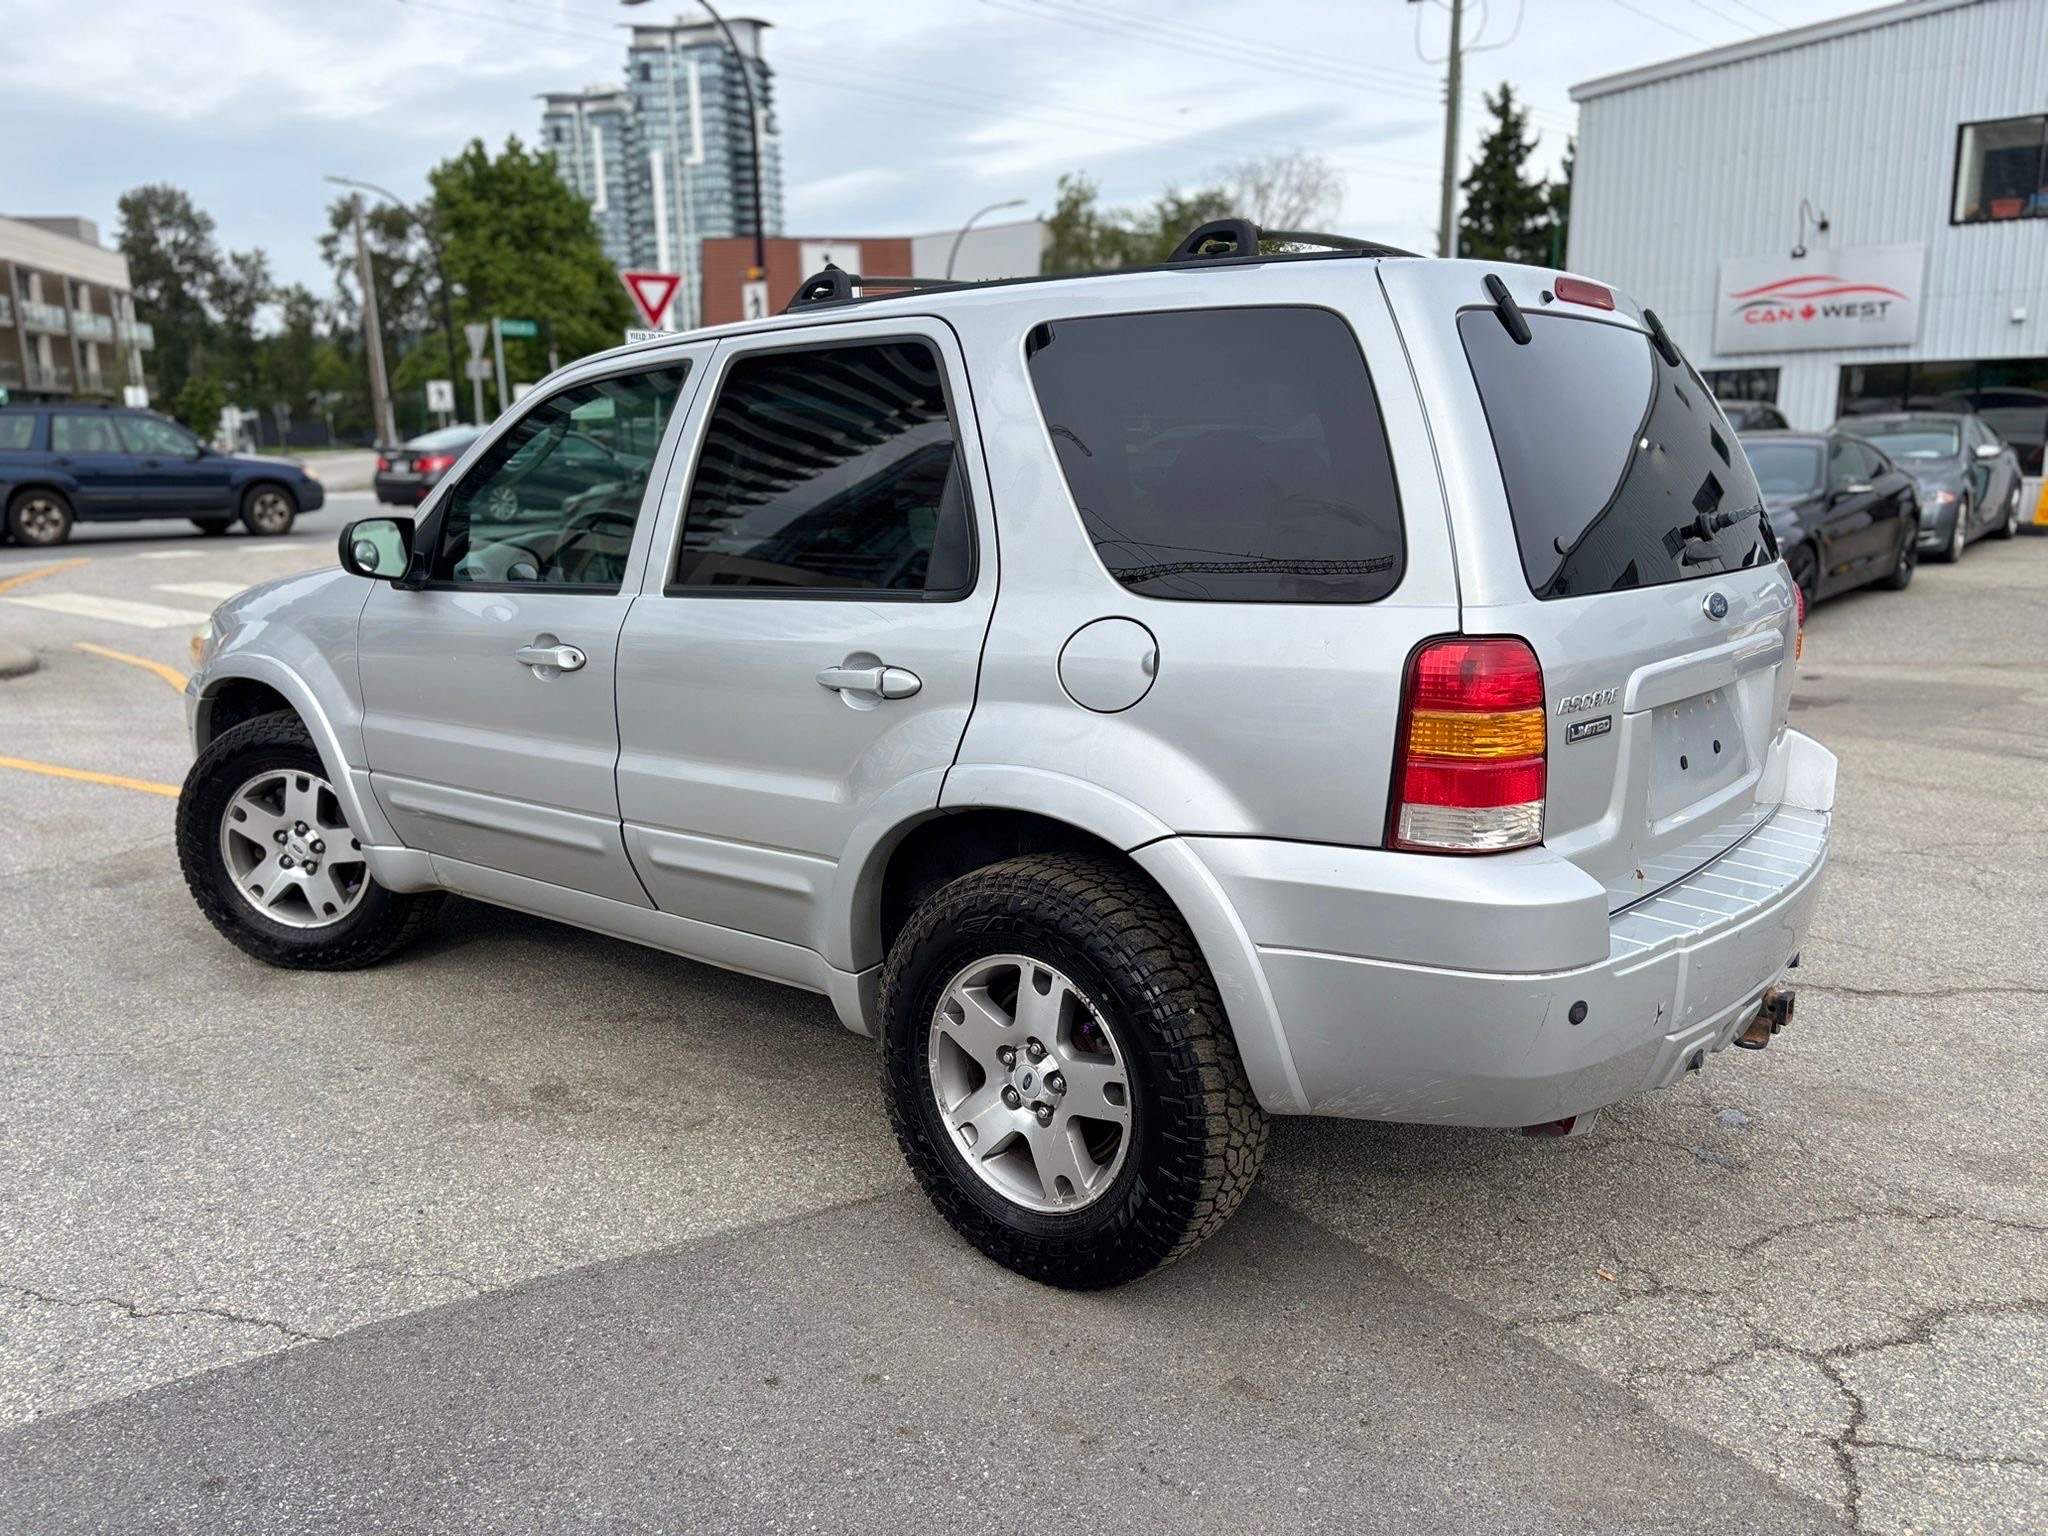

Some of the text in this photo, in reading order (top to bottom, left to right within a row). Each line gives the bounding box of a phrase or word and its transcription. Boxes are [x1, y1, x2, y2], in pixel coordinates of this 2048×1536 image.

[1744, 302, 1891, 324] CAN WEST
[1556, 686, 1620, 716] ESCAPE
[1571, 720, 1610, 738] LIMITED
